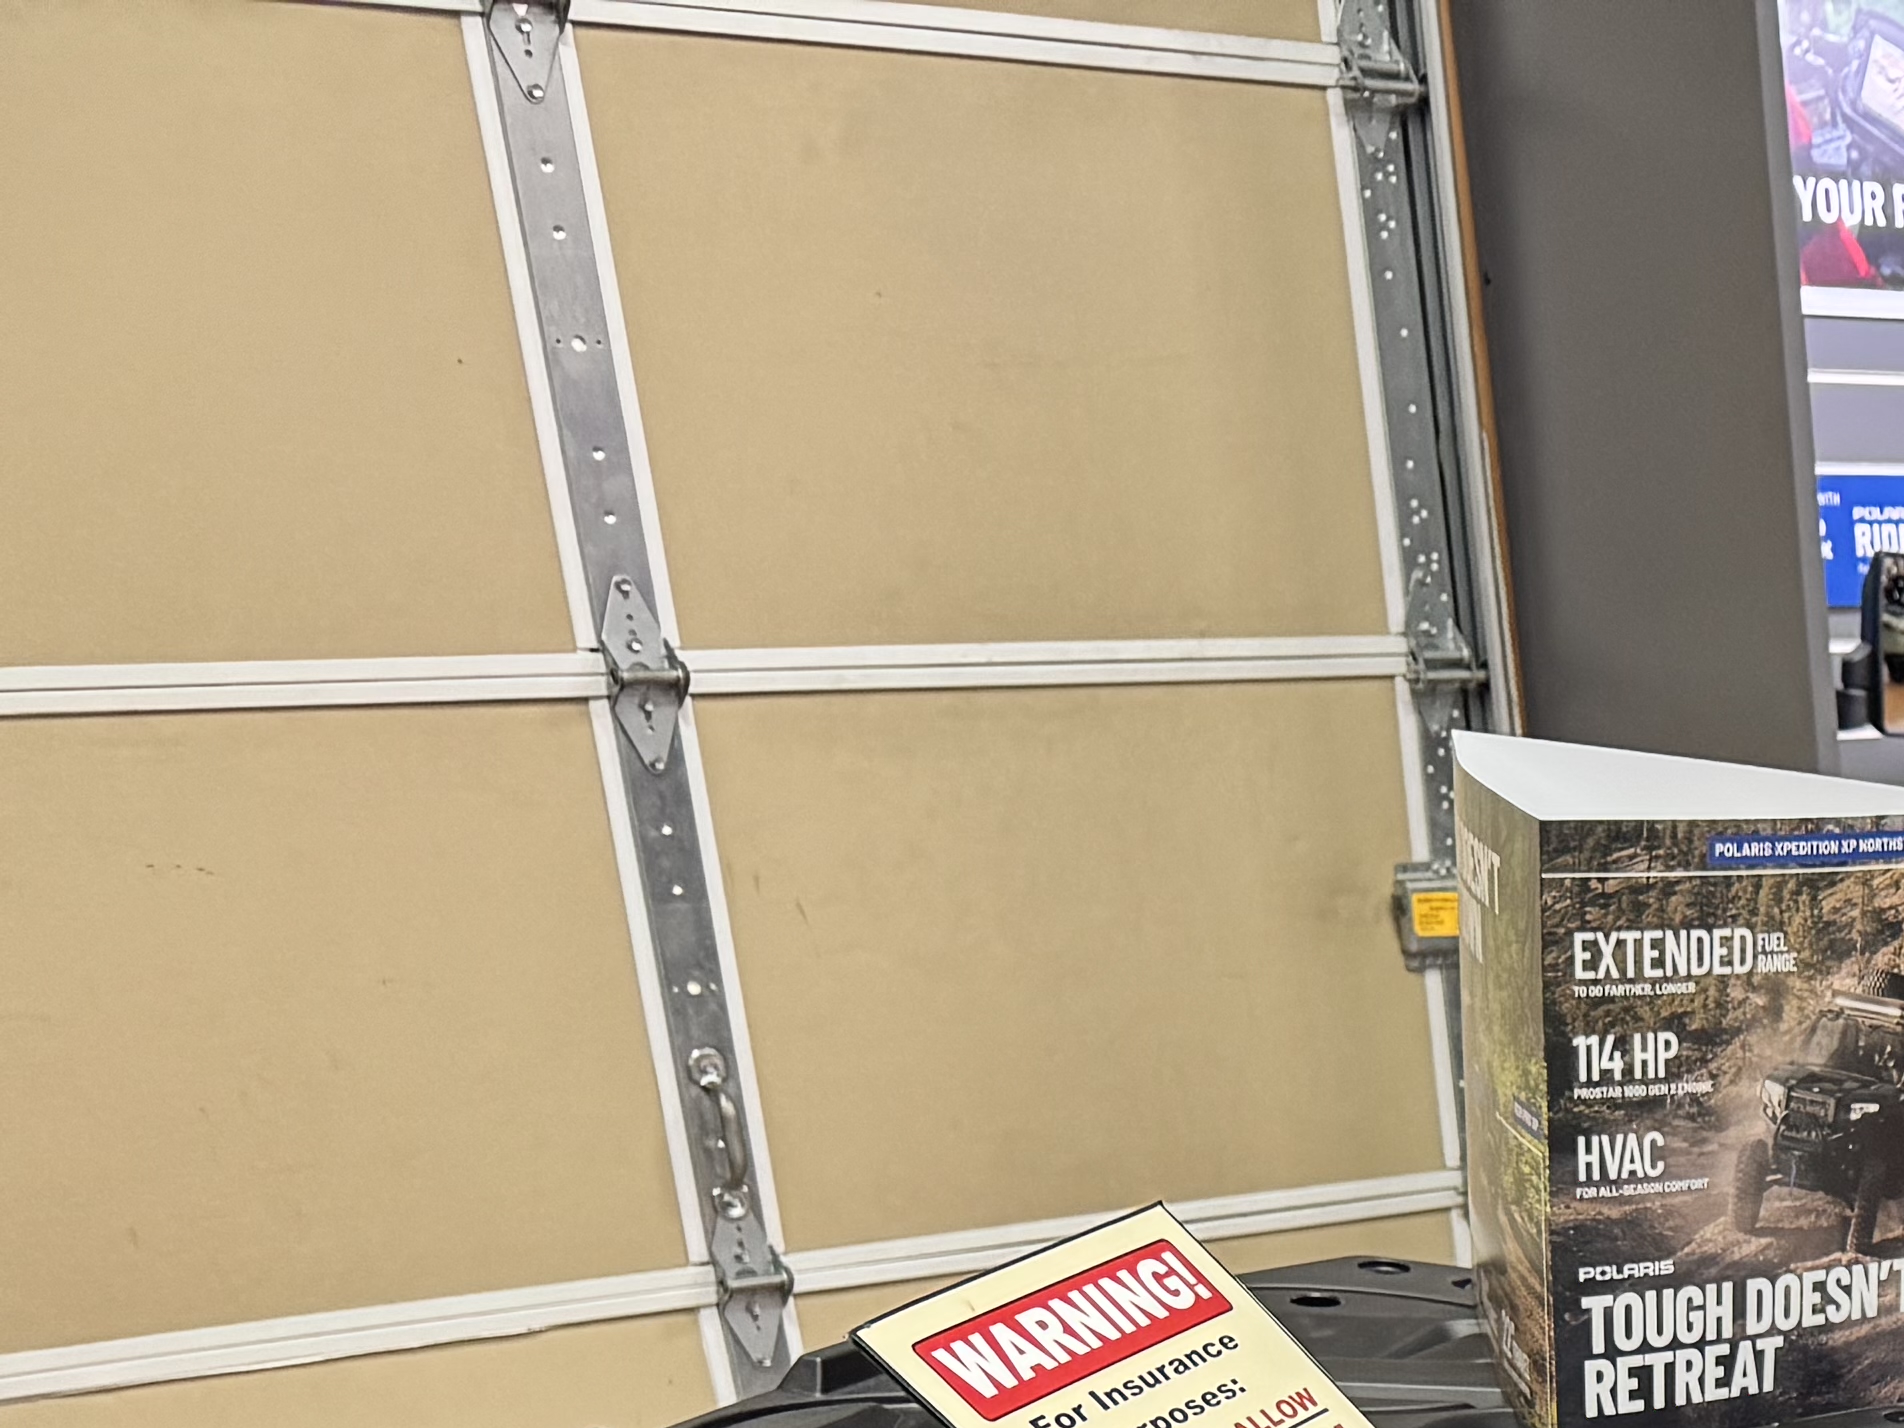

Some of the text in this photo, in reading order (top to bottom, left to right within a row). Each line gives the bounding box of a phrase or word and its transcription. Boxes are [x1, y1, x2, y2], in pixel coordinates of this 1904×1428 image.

[1793, 176, 1886, 226] YOUR
[1715, 841, 1772, 858] POLARIS
[1775, 838, 1838, 857] XPEDITION
[1841, 837, 1858, 854] XP
[1573, 928, 1788, 980] EXTENDED FUEL
[1757, 952, 1798, 974] RANGE
[1573, 986, 1587, 998] TO
[1656, 981, 1696, 995] LONGER
[1572, 1031, 1679, 1083] 114 HP
[1573, 1085, 1622, 1099] PROSTAR
[1577, 1130, 1665, 1182] HVAC
[1576, 1177, 1709, 1199] FOR ALL-SEASON COMFORT
[1578, 1259, 1675, 1283] POLARIS
[932, 1250, 1214, 1399] WARNING!
[1581, 1281, 1734, 1355] TOUGH
[1097, 1331, 1239, 1413] Insurance
[1583, 1335, 1785, 1419] RETREAT
